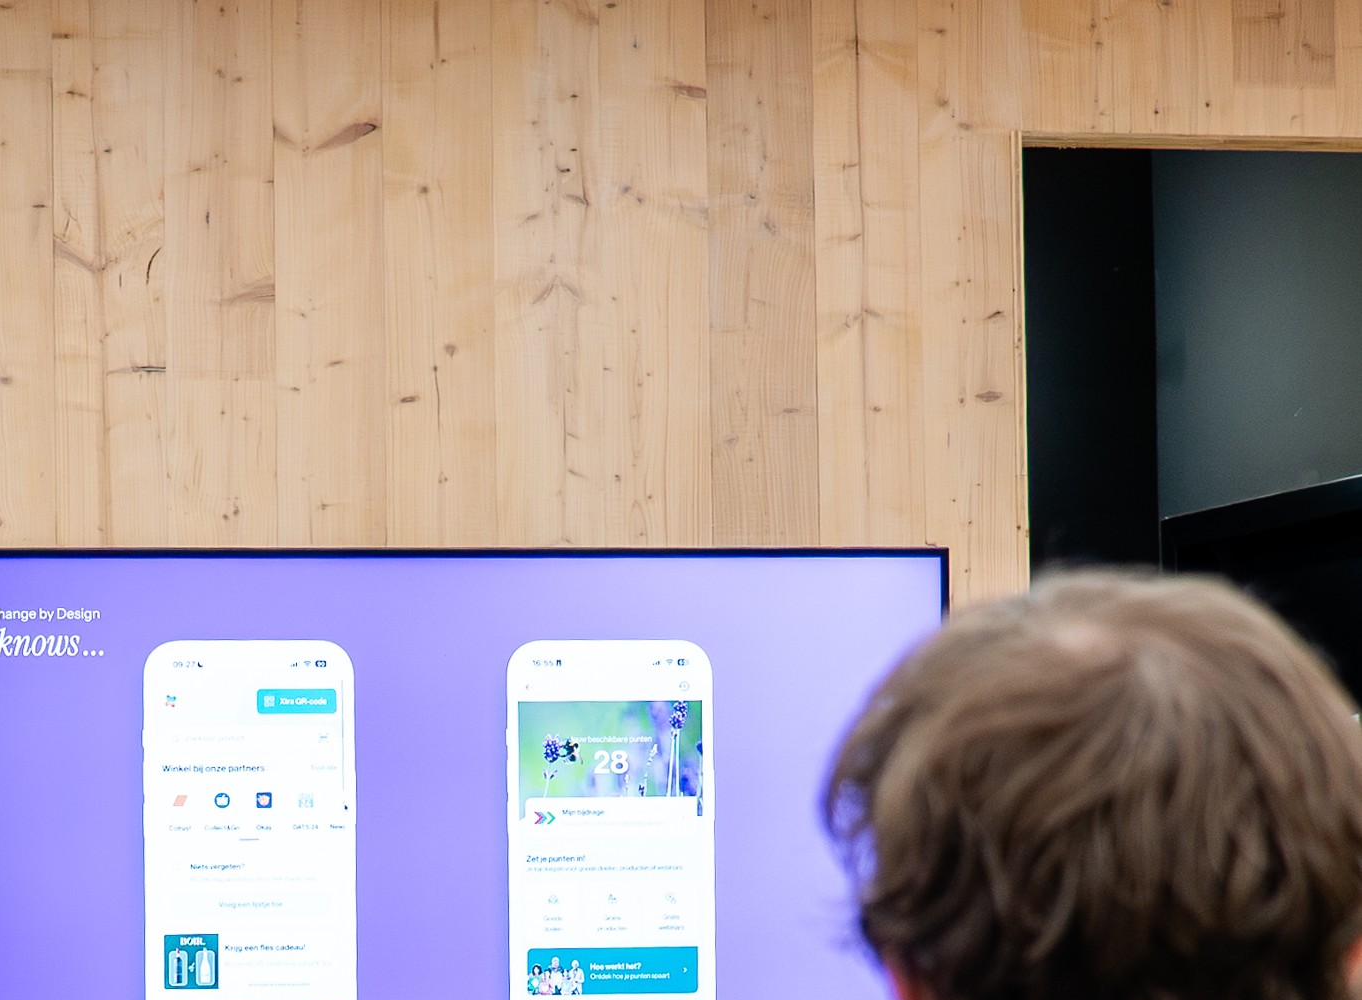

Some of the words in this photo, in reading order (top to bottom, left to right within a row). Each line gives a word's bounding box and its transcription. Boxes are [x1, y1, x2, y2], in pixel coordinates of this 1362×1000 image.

[39, 607, 55, 623] by
[56, 607, 102, 623] Design
[295, 697, 328, 706] QR-code
[629, 736, 653, 745] punten
[593, 749, 630, 775] 28
[161, 763, 192, 773] Winkel
[193, 763, 204, 775] bij
[205, 765, 227, 773] onze
[228, 764, 266, 775] partners
[526, 855, 539, 863] Zet
[540, 855, 547, 865] je
[548, 855, 575, 865] punten
[190, 863, 208, 871] Niets
[224, 943, 243, 953] Krijg
[244, 944, 259, 952] een
[276, 943, 306, 952] cadeau!
[589, 962, 604, 971] Hoe
[605, 962, 624, 971] werkt
[625, 961, 643, 971] het?
[589, 972, 611, 980] Ontdek
[612, 972, 623, 980] hoe
[630, 972, 651, 981] punten
